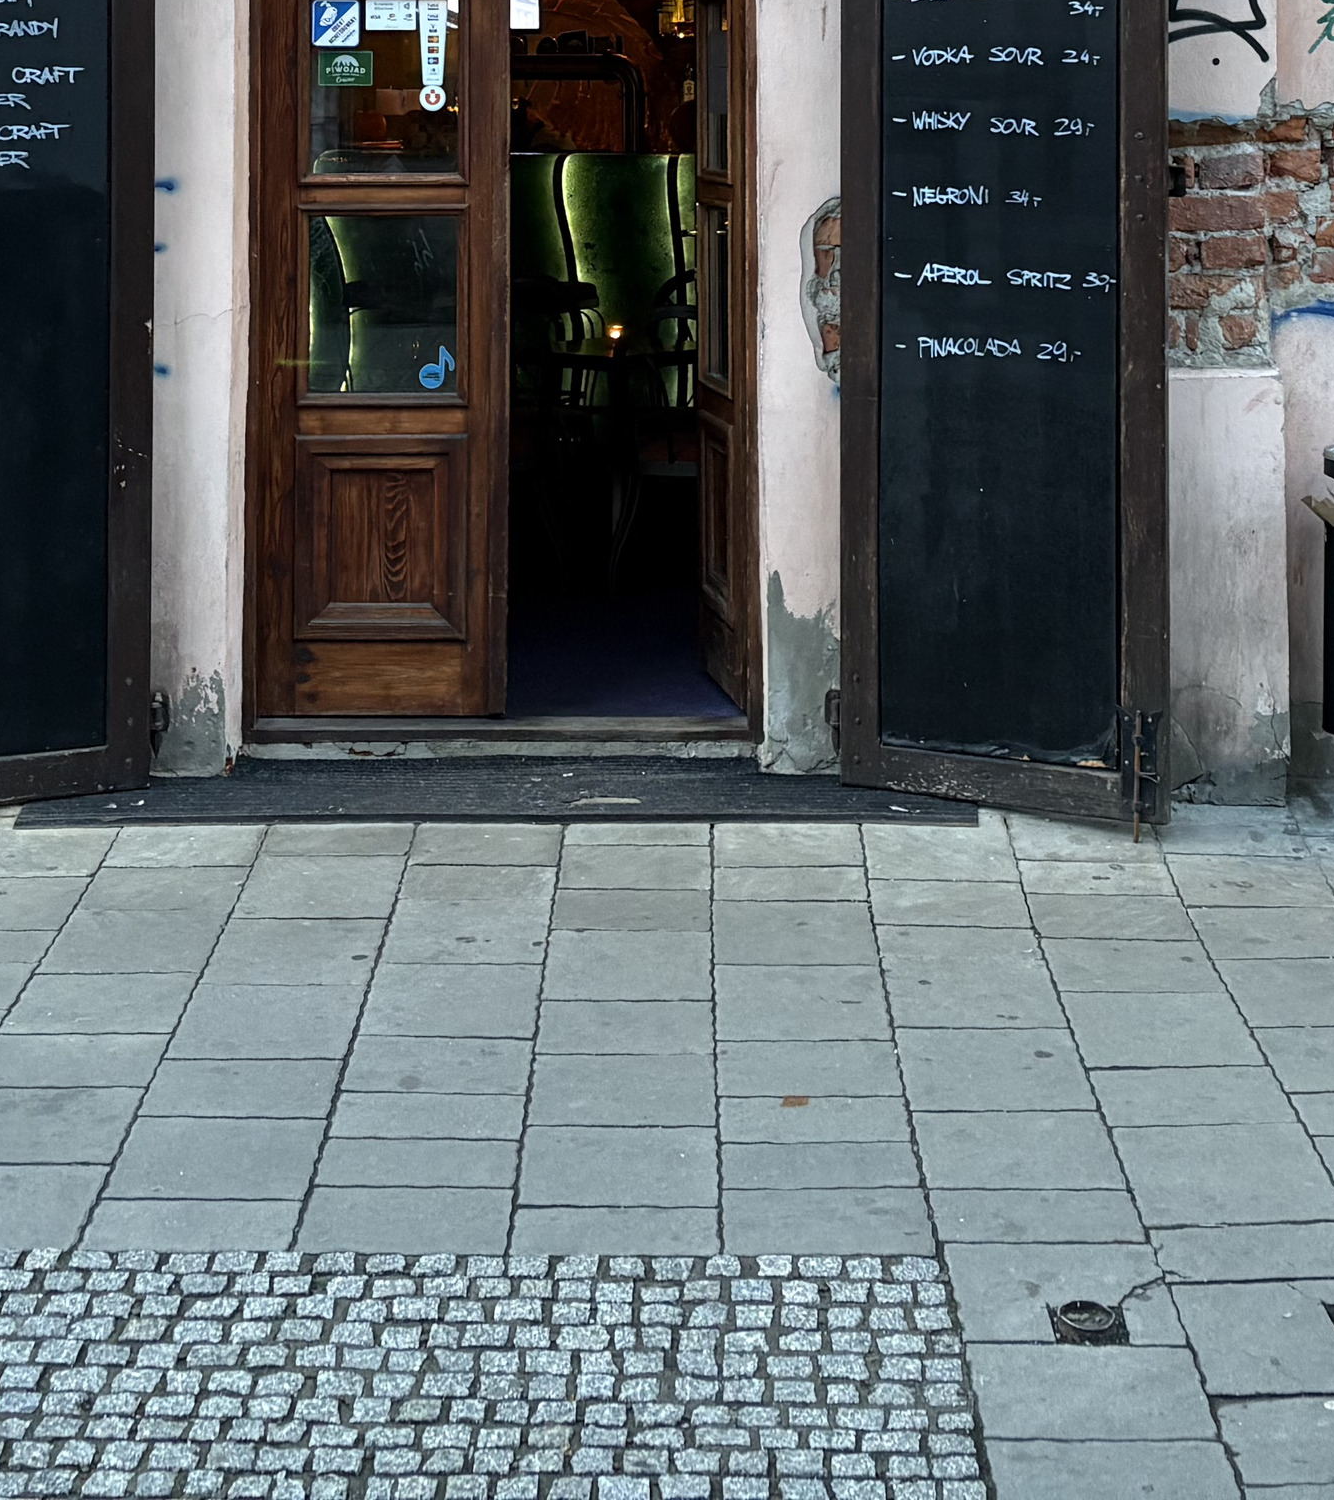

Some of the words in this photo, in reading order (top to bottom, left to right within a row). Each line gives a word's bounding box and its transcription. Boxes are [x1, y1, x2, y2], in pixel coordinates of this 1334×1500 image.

[12, 67, 85, 84] CRAFT
[325, 66, 366, 74] PIWOJAD
[1007, 270, 1071, 289] SPRITZ
